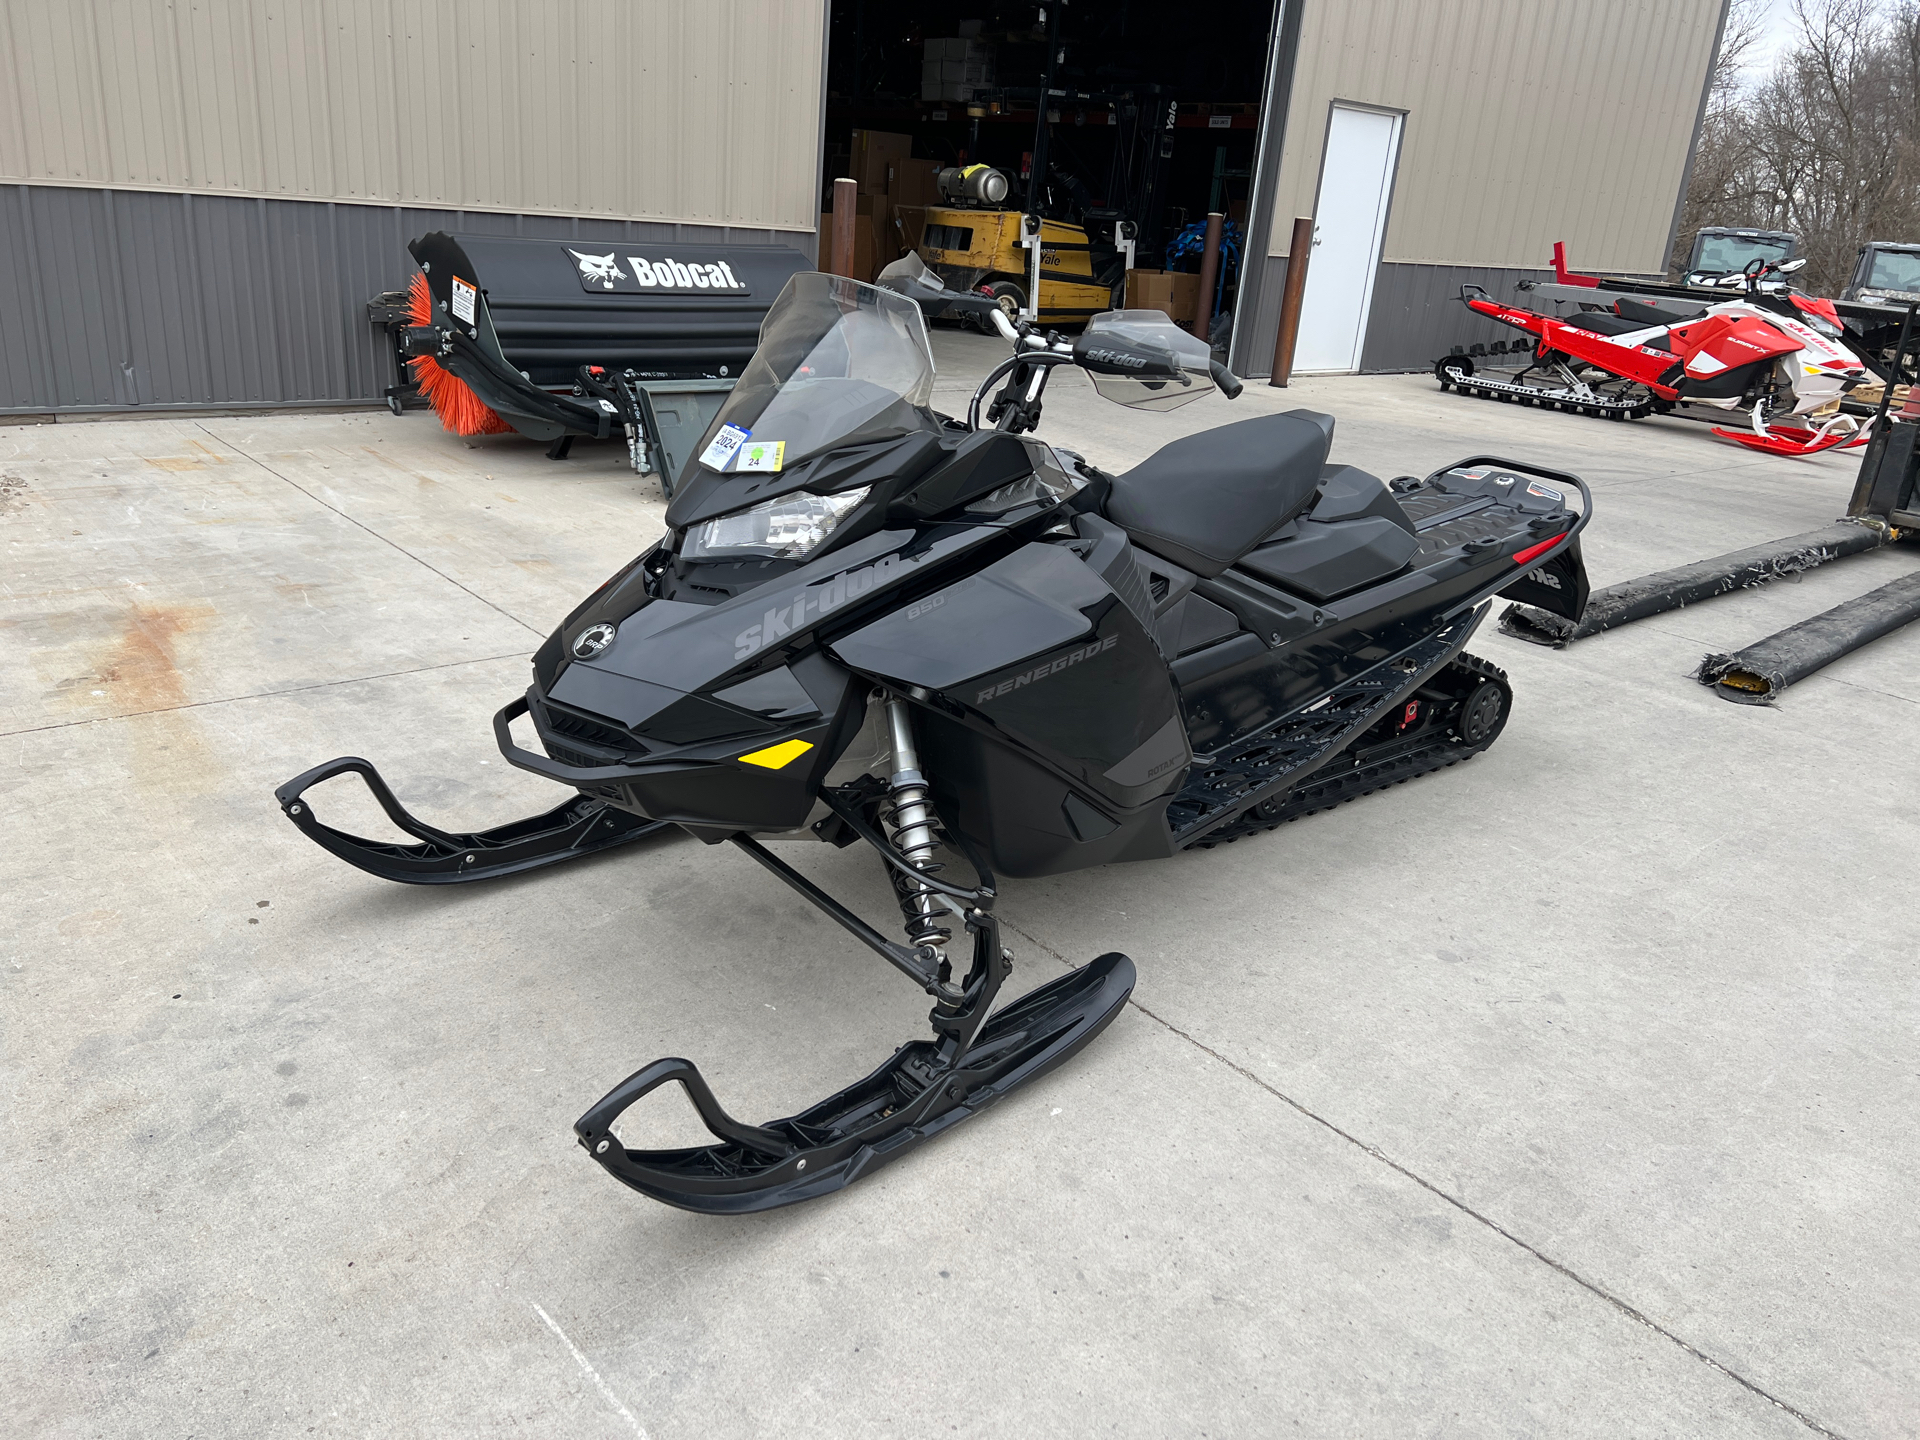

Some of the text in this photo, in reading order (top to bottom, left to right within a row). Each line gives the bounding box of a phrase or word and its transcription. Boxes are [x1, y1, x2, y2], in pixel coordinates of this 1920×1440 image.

[1166, 101, 1177, 129] Yale
[928, 250, 941, 260] Yale
[1040, 253, 1061, 266] Yale
[627, 256, 739, 288] Bobcat
[1726, 336, 1771, 354] SUMMIT X
[1085, 349, 1148, 369] ski-doo
[715, 434, 738, 450] 2024
[748, 458, 760, 467] 24
[733, 553, 901, 661] ski-doo
[907, 595, 945, 620] 850
[585, 639, 604, 649] BRP
[976, 633, 1120, 705] RENEGADE
[1147, 758, 1176, 778] ROTAX
